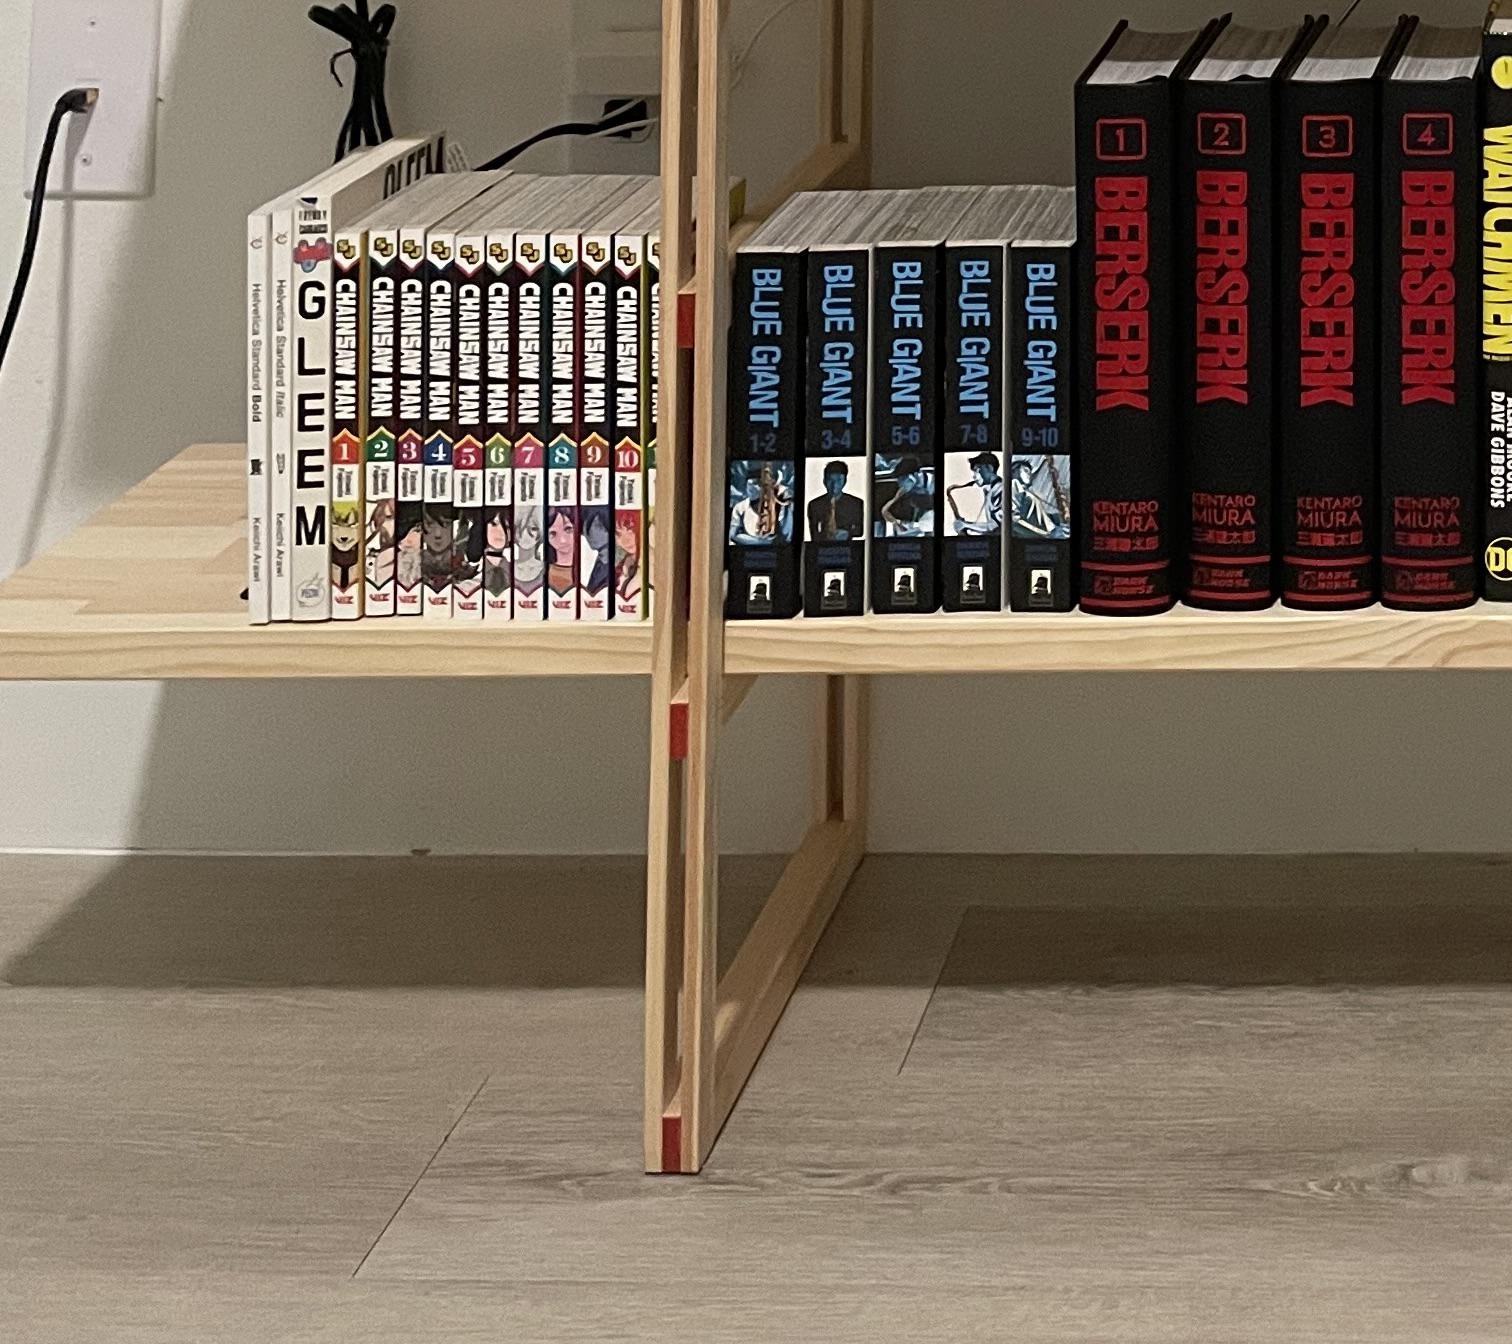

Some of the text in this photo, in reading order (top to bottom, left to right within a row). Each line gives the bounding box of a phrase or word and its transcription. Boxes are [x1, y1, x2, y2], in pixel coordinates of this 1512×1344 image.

[334, 279, 356, 460] CHAINSAW MAN 1
[1023, 264, 1057, 421] BLUE GIANT
[1094, 176, 1149, 411] BERSERK
[1400, 171, 1455, 405] BERSERK
[1490, 391, 1506, 508] DAVE GIBBONS
